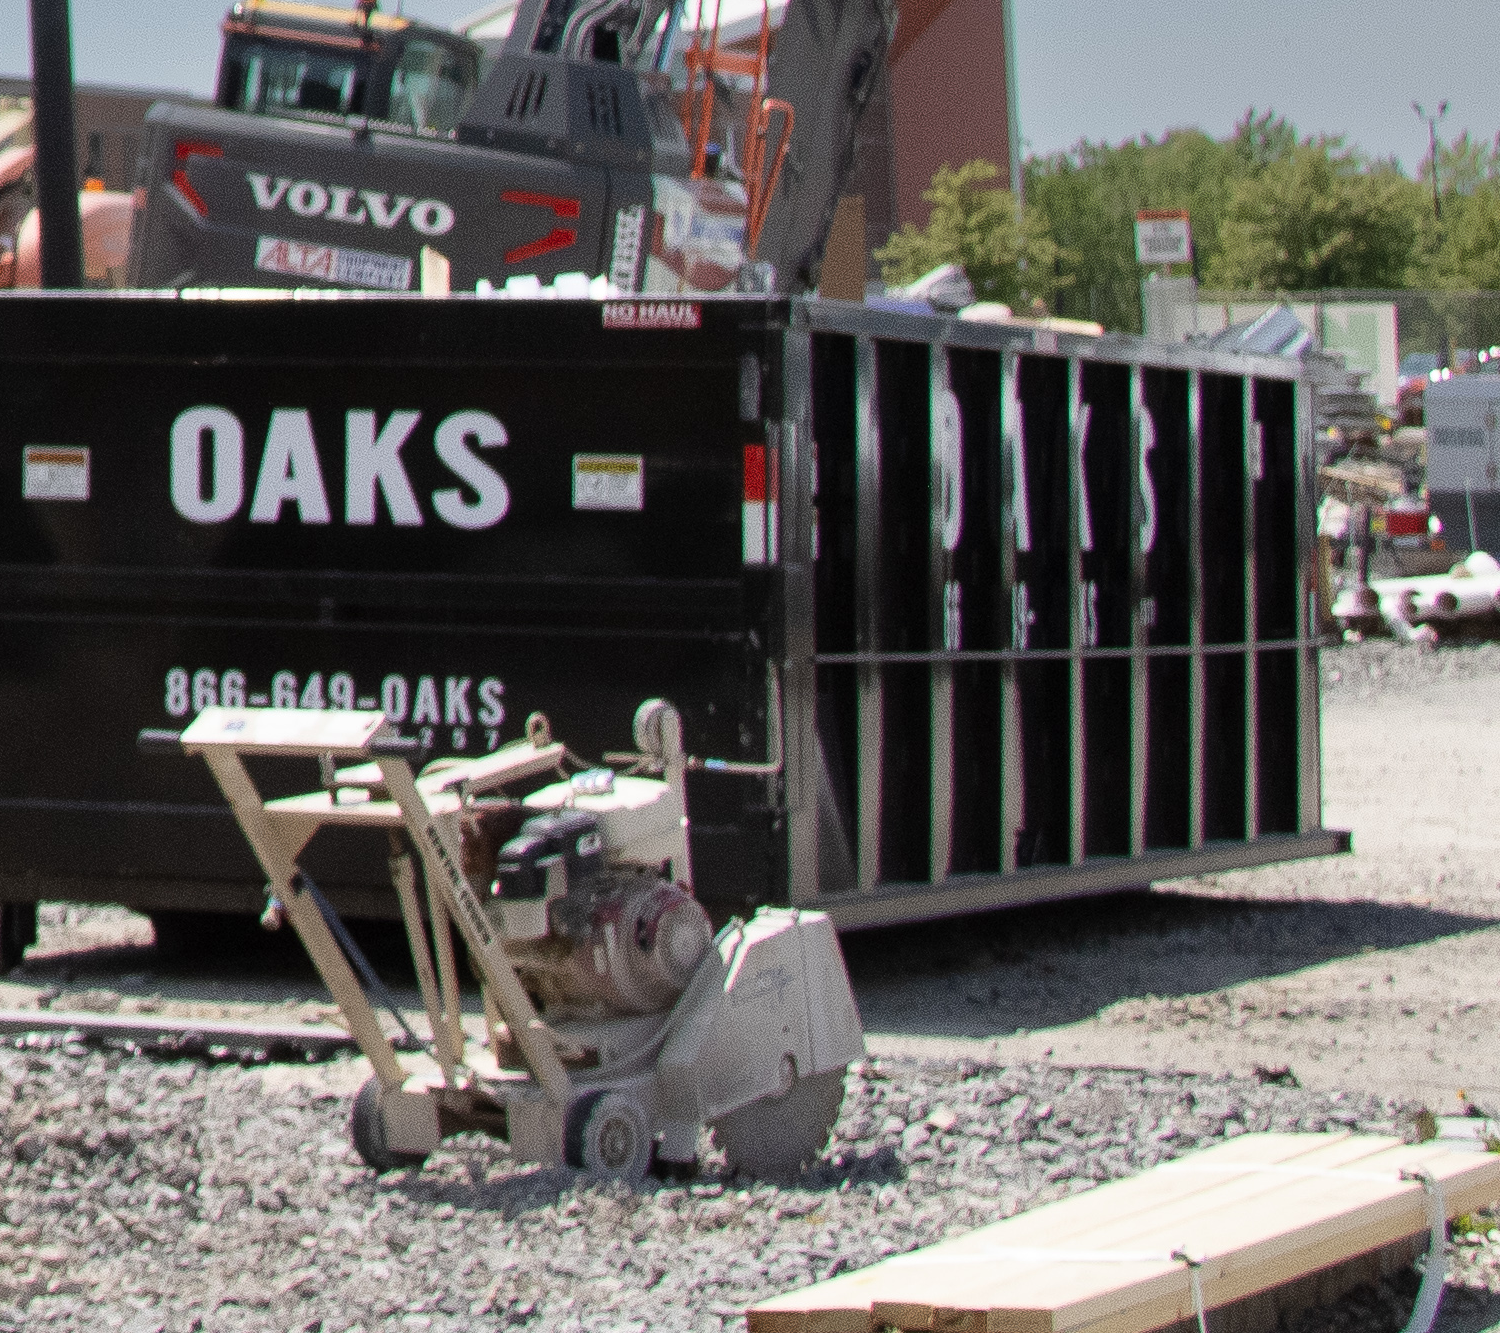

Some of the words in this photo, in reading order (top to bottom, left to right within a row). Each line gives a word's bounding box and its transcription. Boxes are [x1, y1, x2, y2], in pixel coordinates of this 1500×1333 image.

[246, 170, 456, 236] VOLVO
[169, 404, 511, 530] OAKS
[164, 666, 506, 729] 866-649-OAKS
